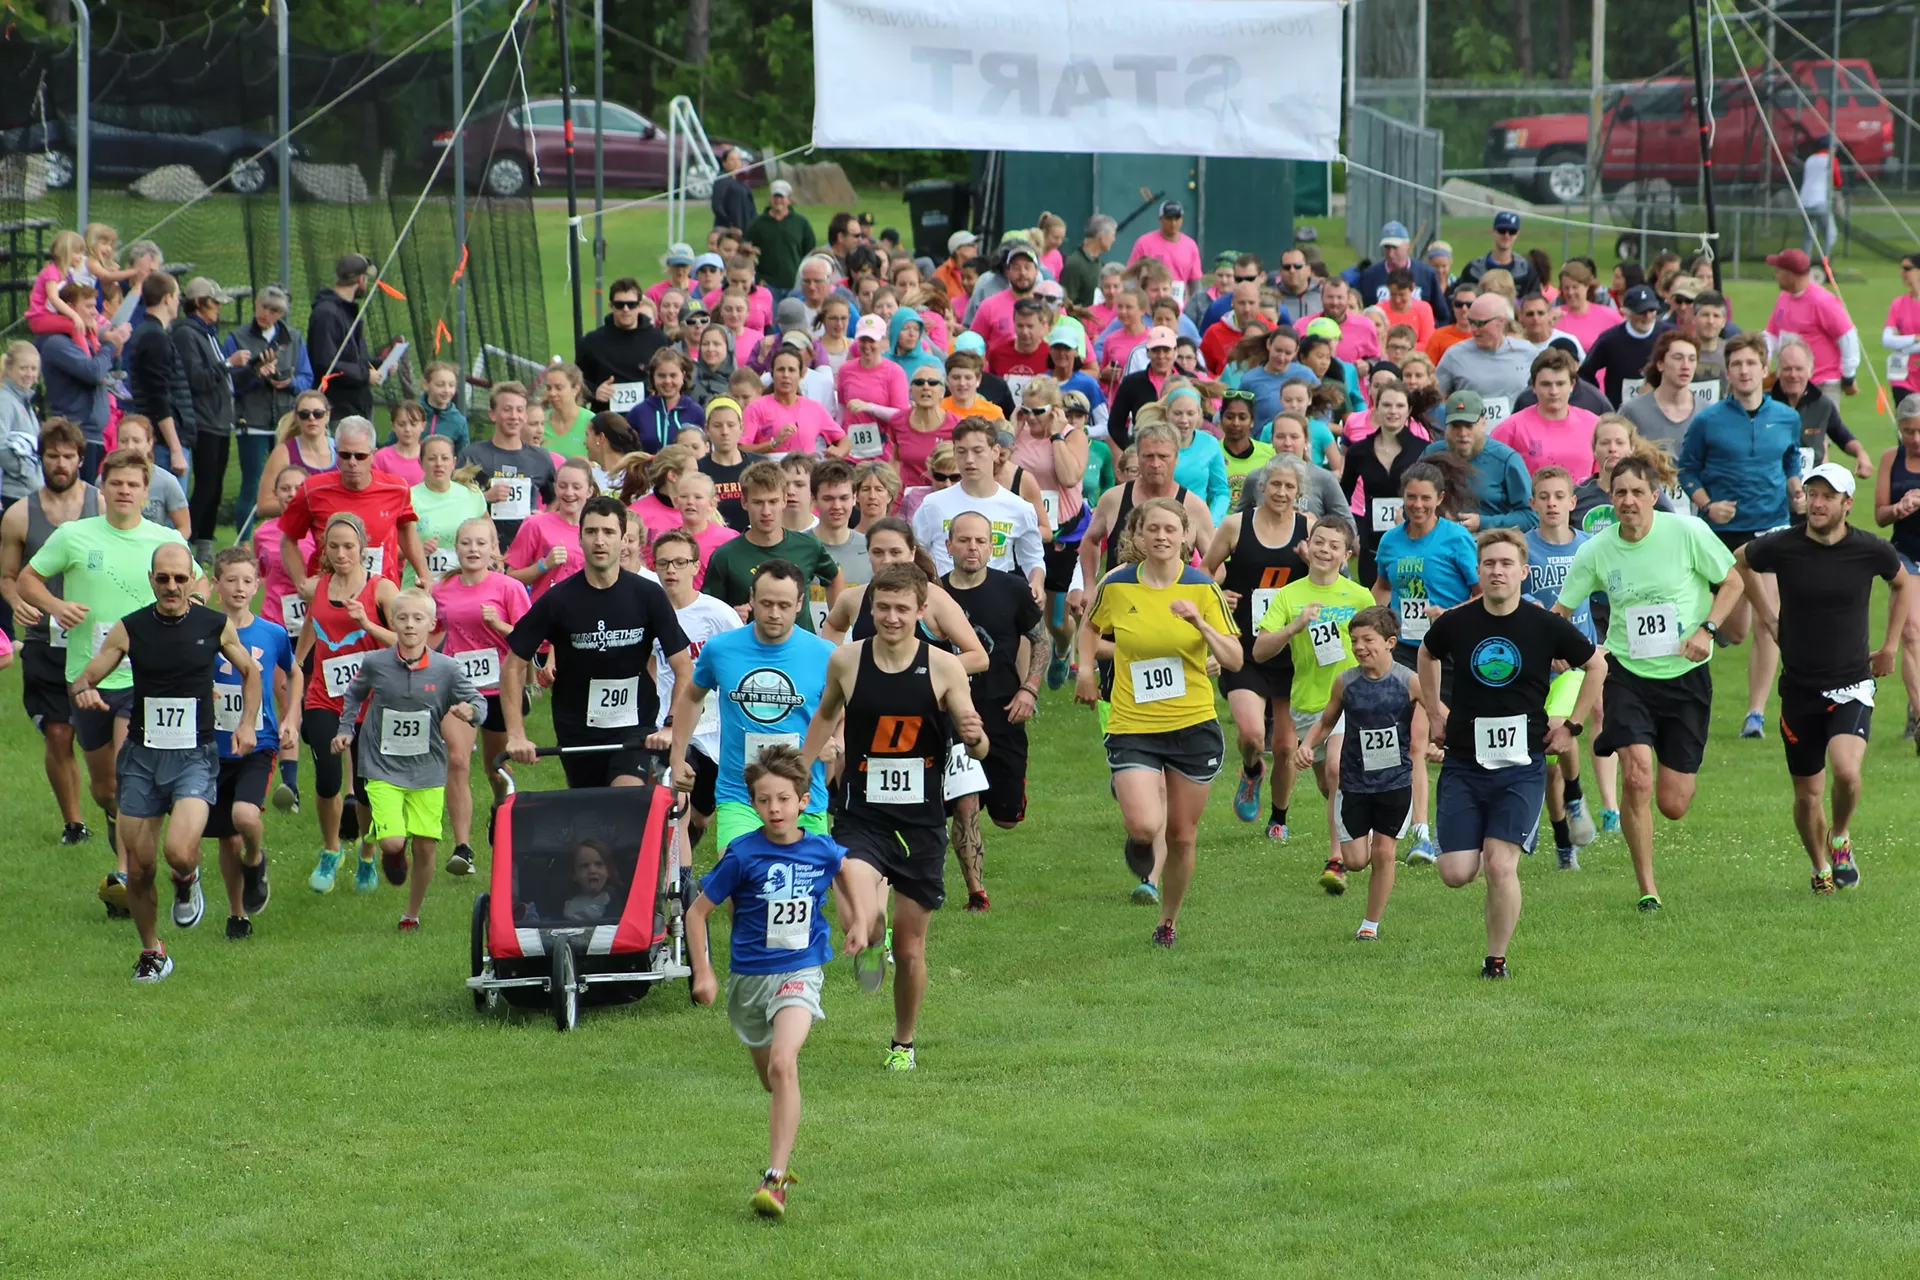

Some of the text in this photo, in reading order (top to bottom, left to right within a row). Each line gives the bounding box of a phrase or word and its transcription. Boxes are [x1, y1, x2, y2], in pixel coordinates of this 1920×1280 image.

[617, 390, 638, 404] 229
[853, 430, 872, 445] 183
[1396, 565, 1423, 573] RUN
[1531, 564, 1569, 594] RAP
[1403, 601, 1428, 620] 231
[1310, 621, 1340, 646] 234
[1637, 614, 1666, 636] 283
[464, 658, 490, 678] 129
[1143, 666, 1173, 690] 190
[600, 688, 628, 708] 290
[731, 692, 803, 704] BAY TO BREAKERS
[156, 707, 185, 727] 177
[393, 720, 420, 737] 253
[1487, 727, 1516, 748] 197
[1365, 730, 1395, 750] 232
[880, 769, 911, 791] 191
[793, 863, 813, 872] Tampa
[793, 868, 825, 878] International
[793, 877, 812, 886] Airport
[792, 885, 814, 899] 5K
[773, 901, 807, 925] 233
